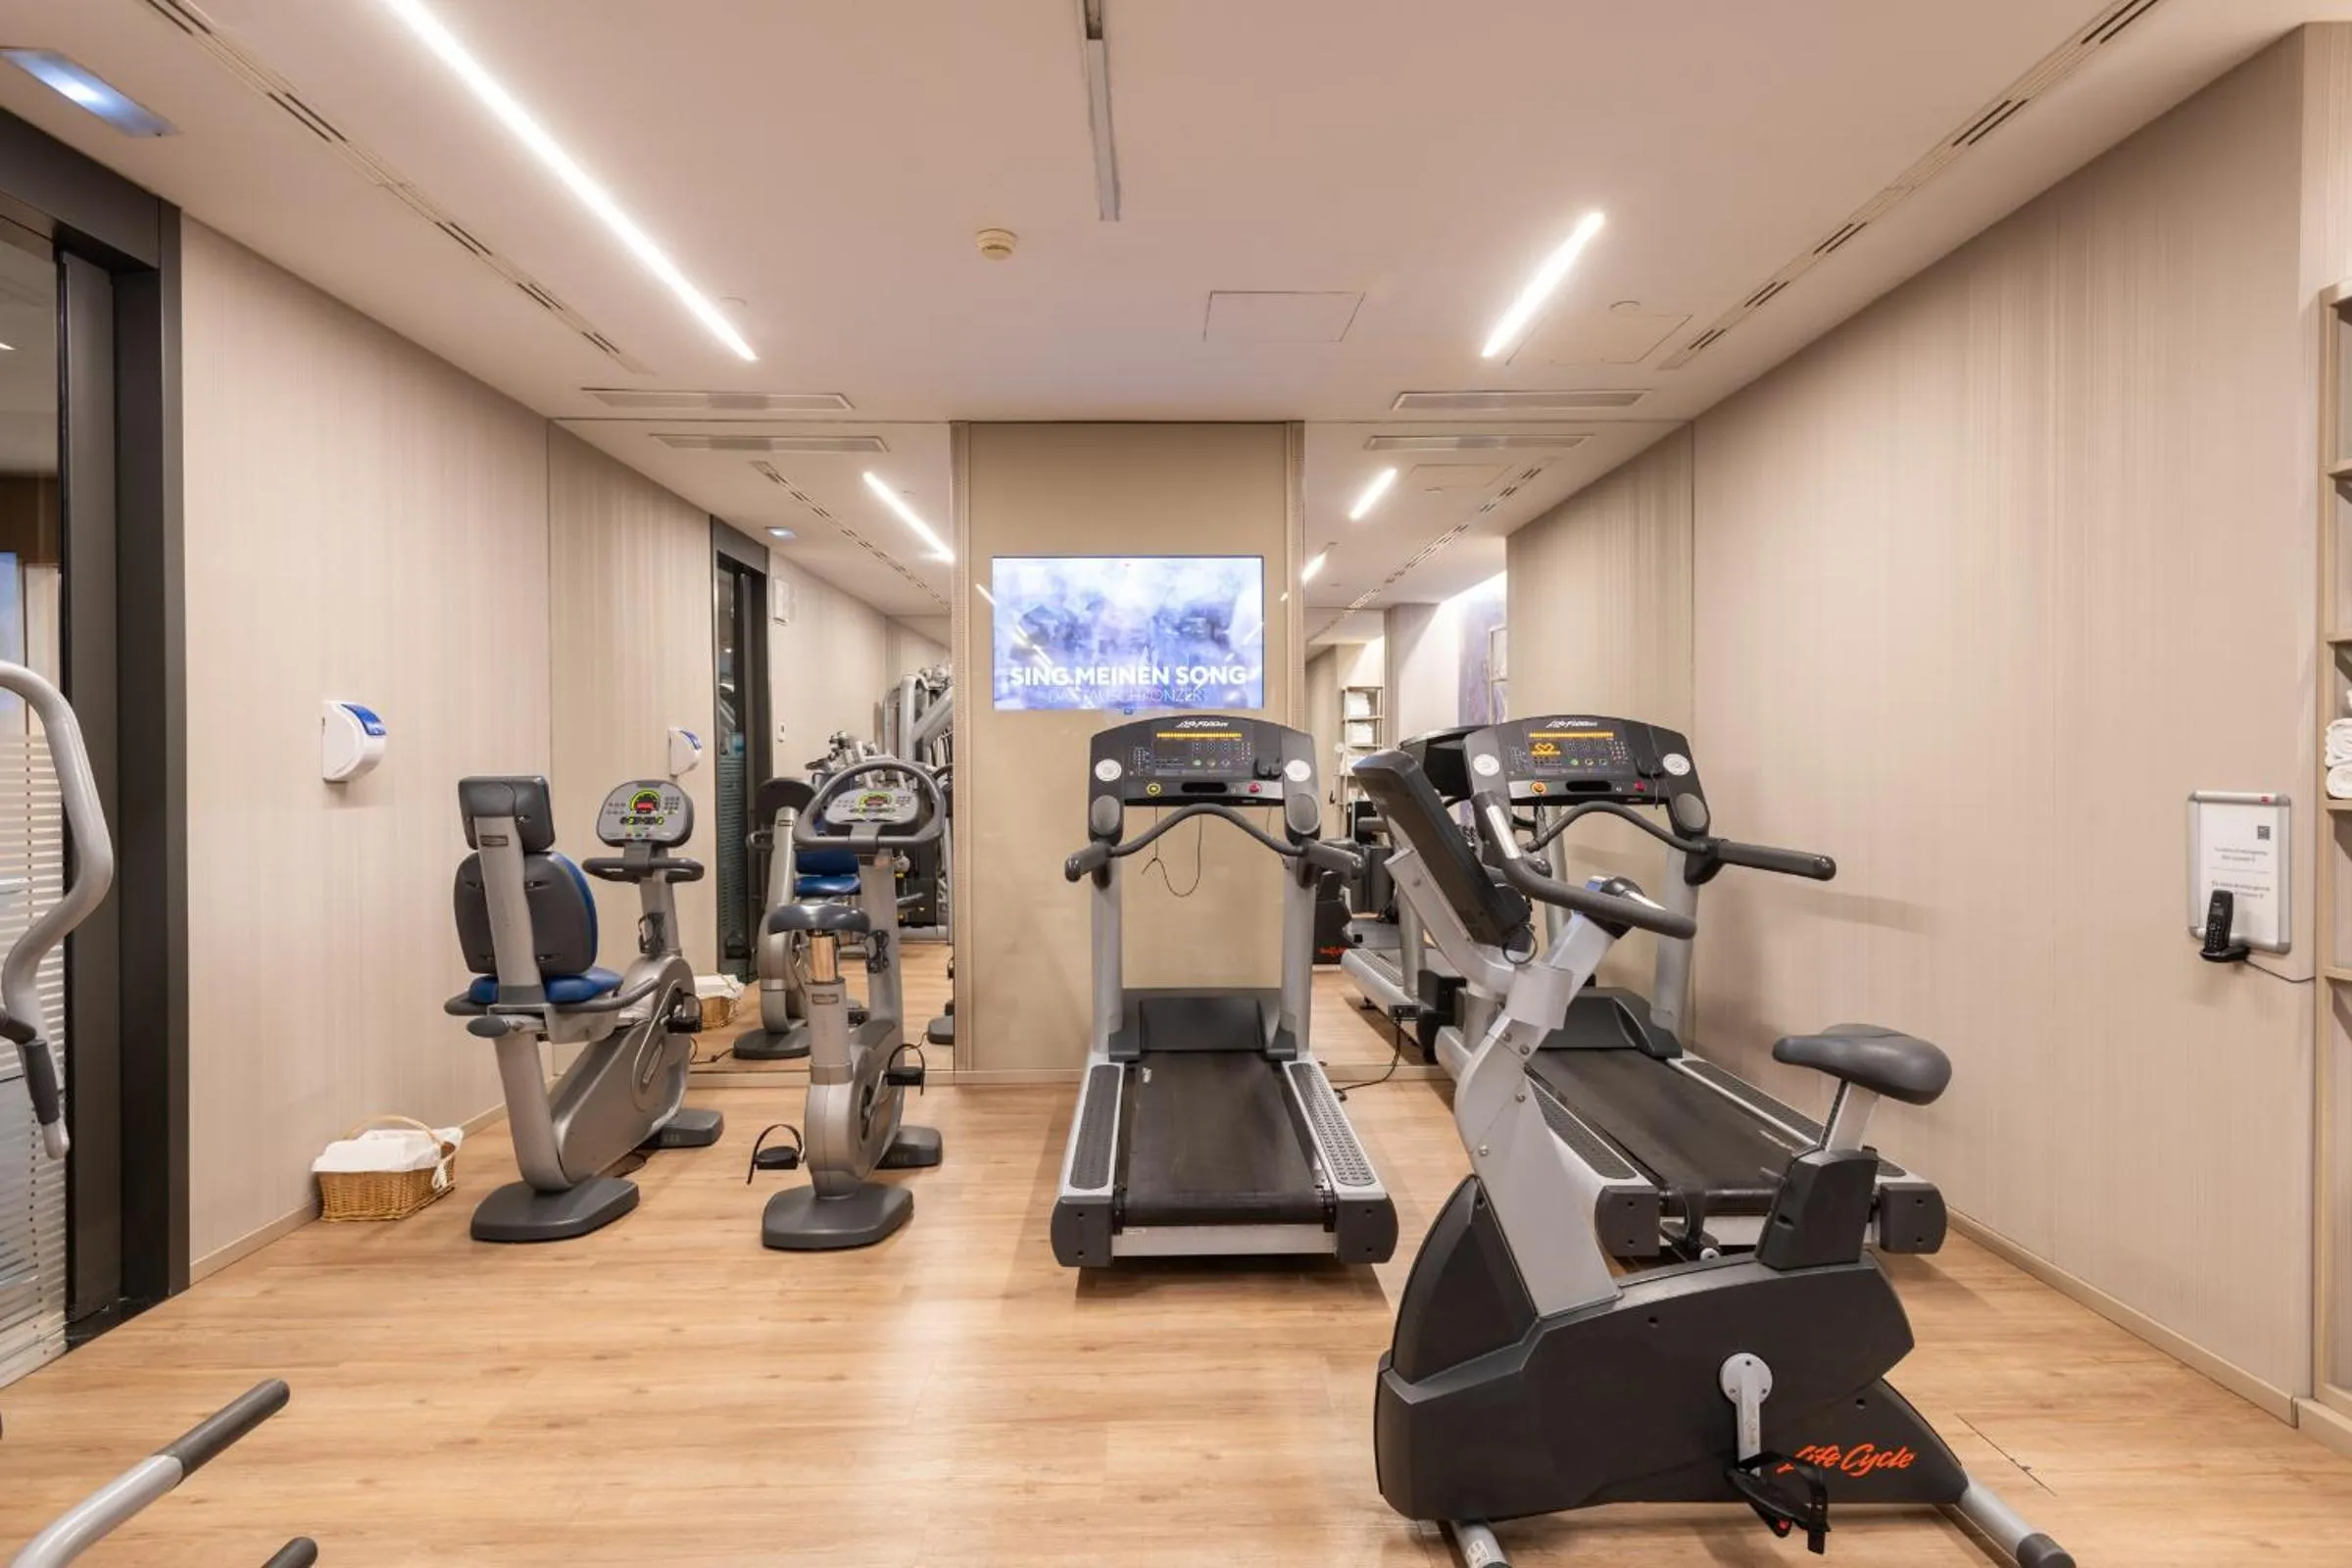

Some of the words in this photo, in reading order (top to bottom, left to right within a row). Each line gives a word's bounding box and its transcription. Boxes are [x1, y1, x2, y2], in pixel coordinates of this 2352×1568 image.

[1010, 666, 1068, 686] SING
[1075, 666, 1169, 686] MEINEN
[1176, 665, 1247, 685] SONG
[1840, 1443, 1914, 1477] Cycle
